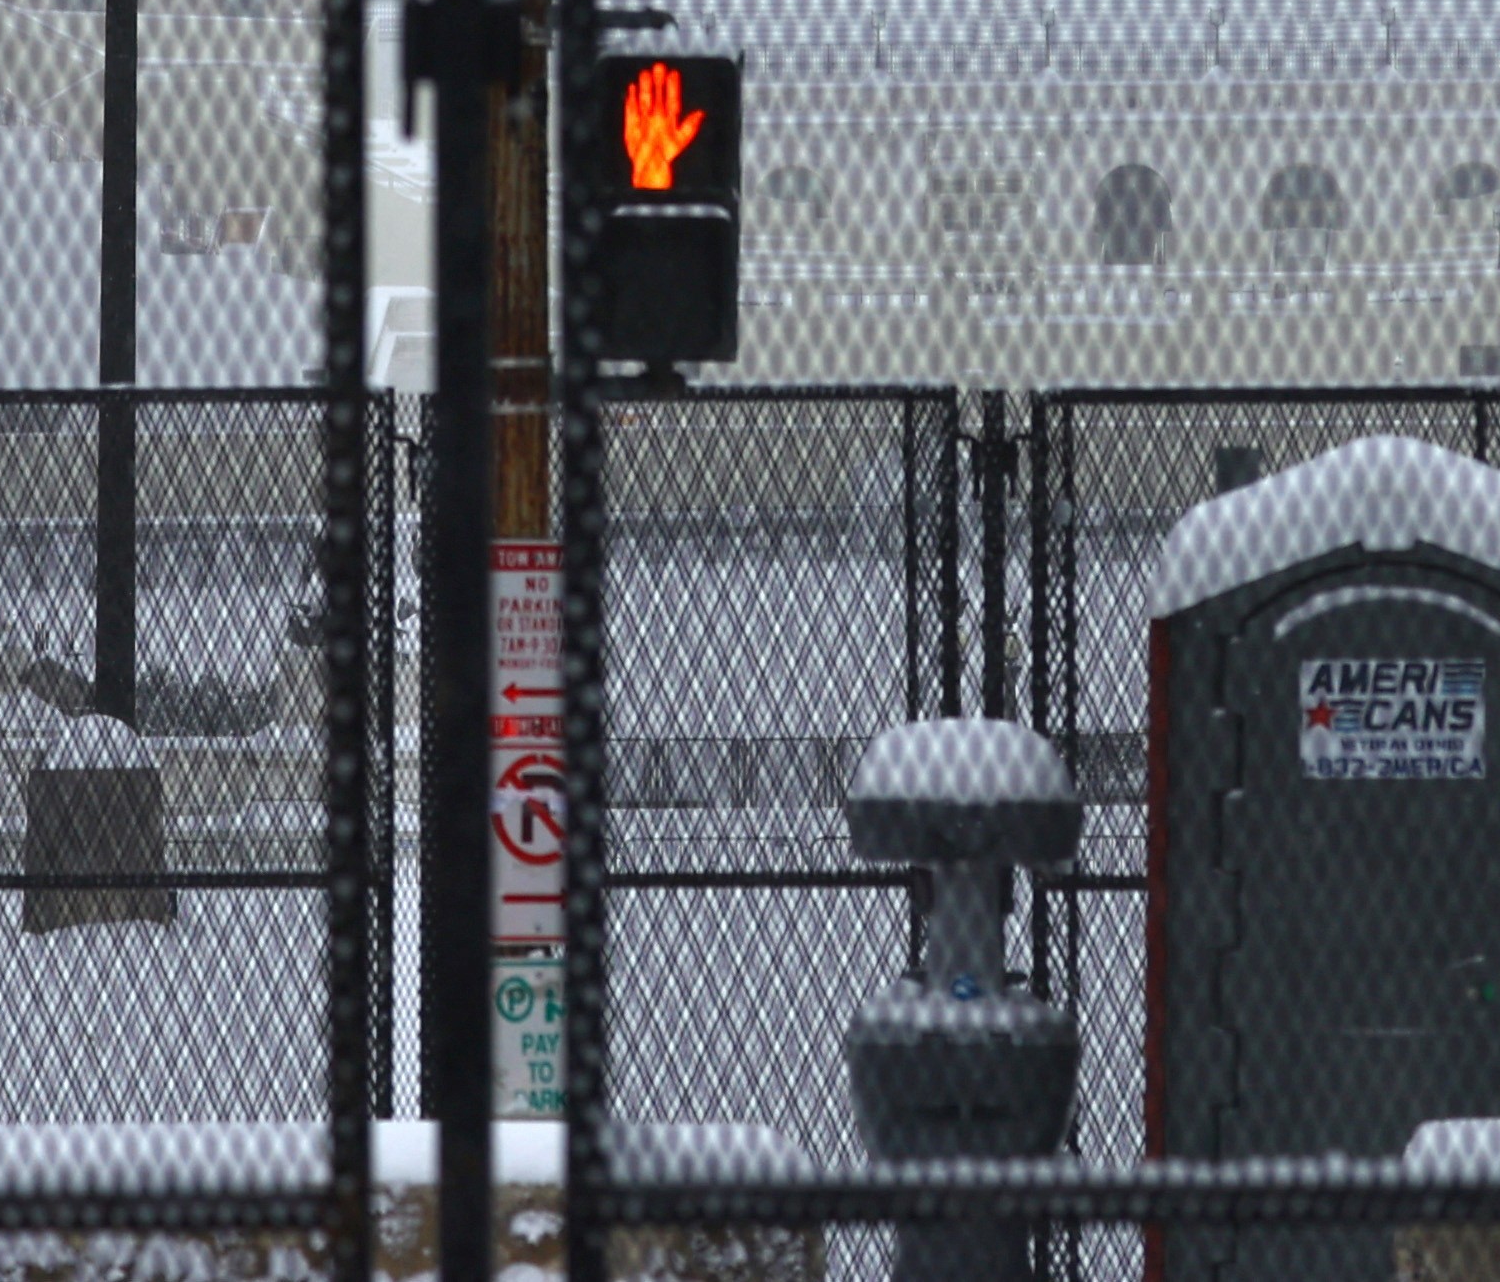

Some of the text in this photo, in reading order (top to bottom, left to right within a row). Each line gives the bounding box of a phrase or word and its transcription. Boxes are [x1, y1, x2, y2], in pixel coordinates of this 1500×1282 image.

[525, 577, 550, 593] NO
[500, 598, 564, 614] PARKIN
[1308, 663, 1439, 695] AMERI
[1363, 700, 1476, 731] CANS
[522, 1034, 560, 1056] PAY
[529, 1061, 553, 1084] TO
[514, 1090, 565, 1112] ARK
